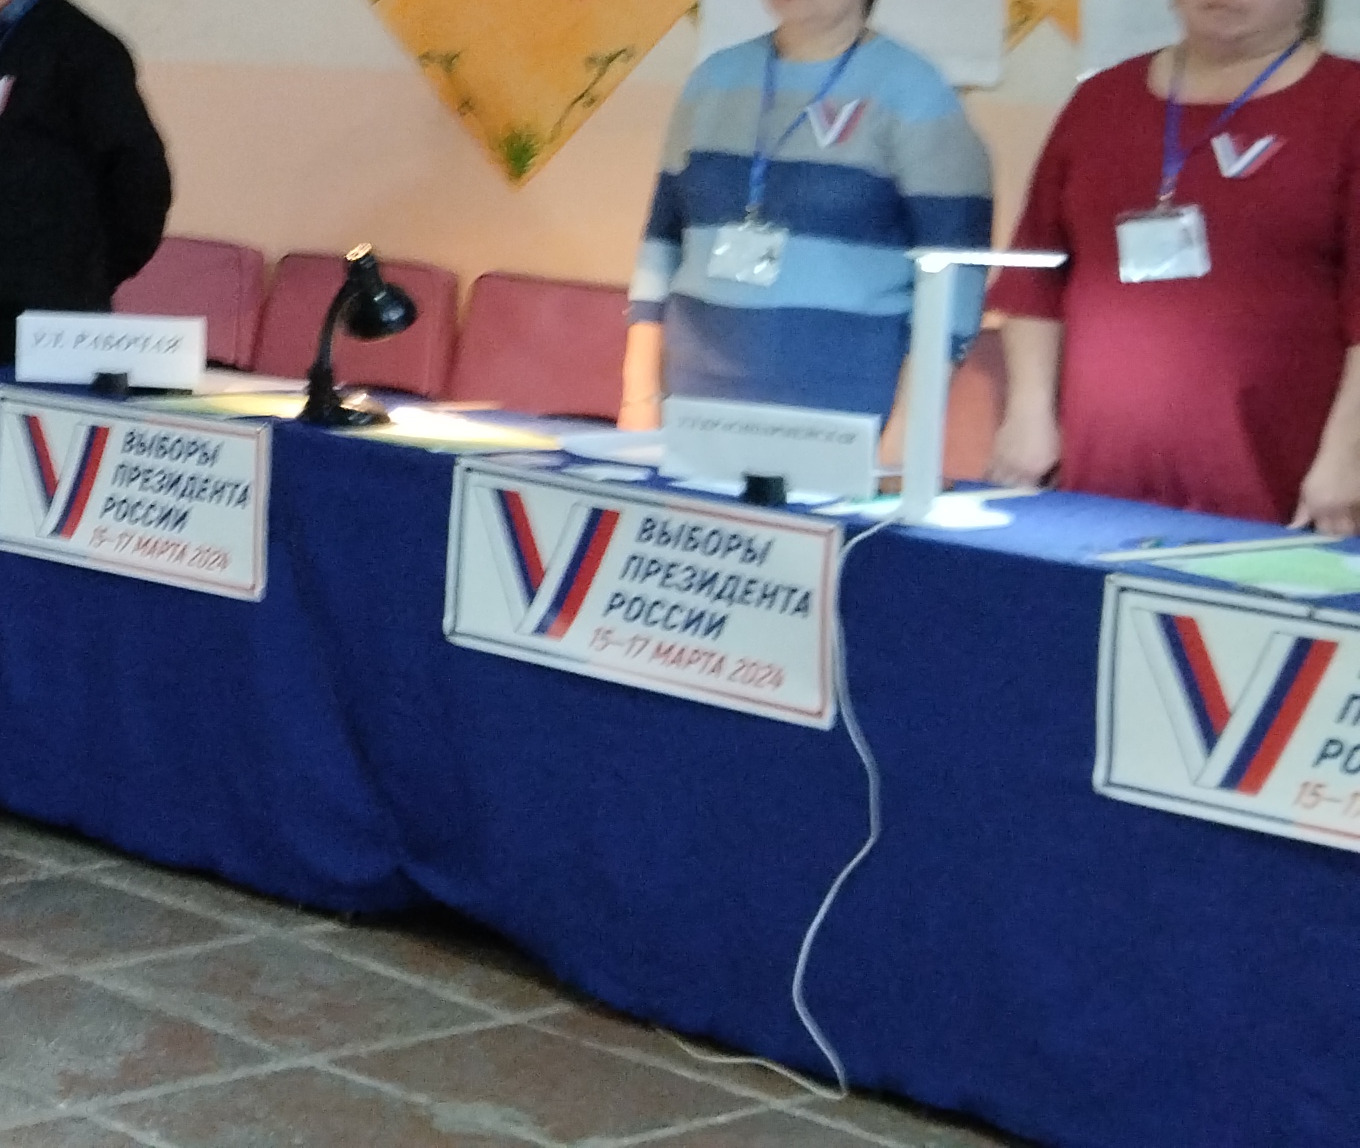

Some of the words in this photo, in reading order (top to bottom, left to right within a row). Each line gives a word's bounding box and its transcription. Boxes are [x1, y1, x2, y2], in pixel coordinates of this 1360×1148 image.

[121, 427, 225, 468] ВЫБОРЫ
[111, 463, 251, 510] ПРЕЗИДЕНТА
[99, 496, 194, 532] РОССИИ
[133, 534, 186, 562] МАРТА
[186, 546, 231, 573] 2024
[635, 516, 776, 567] ВЫБОРЫ
[619, 553, 813, 619] ПРЕЗИДЕНТА
[603, 591, 730, 642] РОССИИ
[651, 643, 726, 679] МАРТА
[727, 657, 787, 690] 2024
